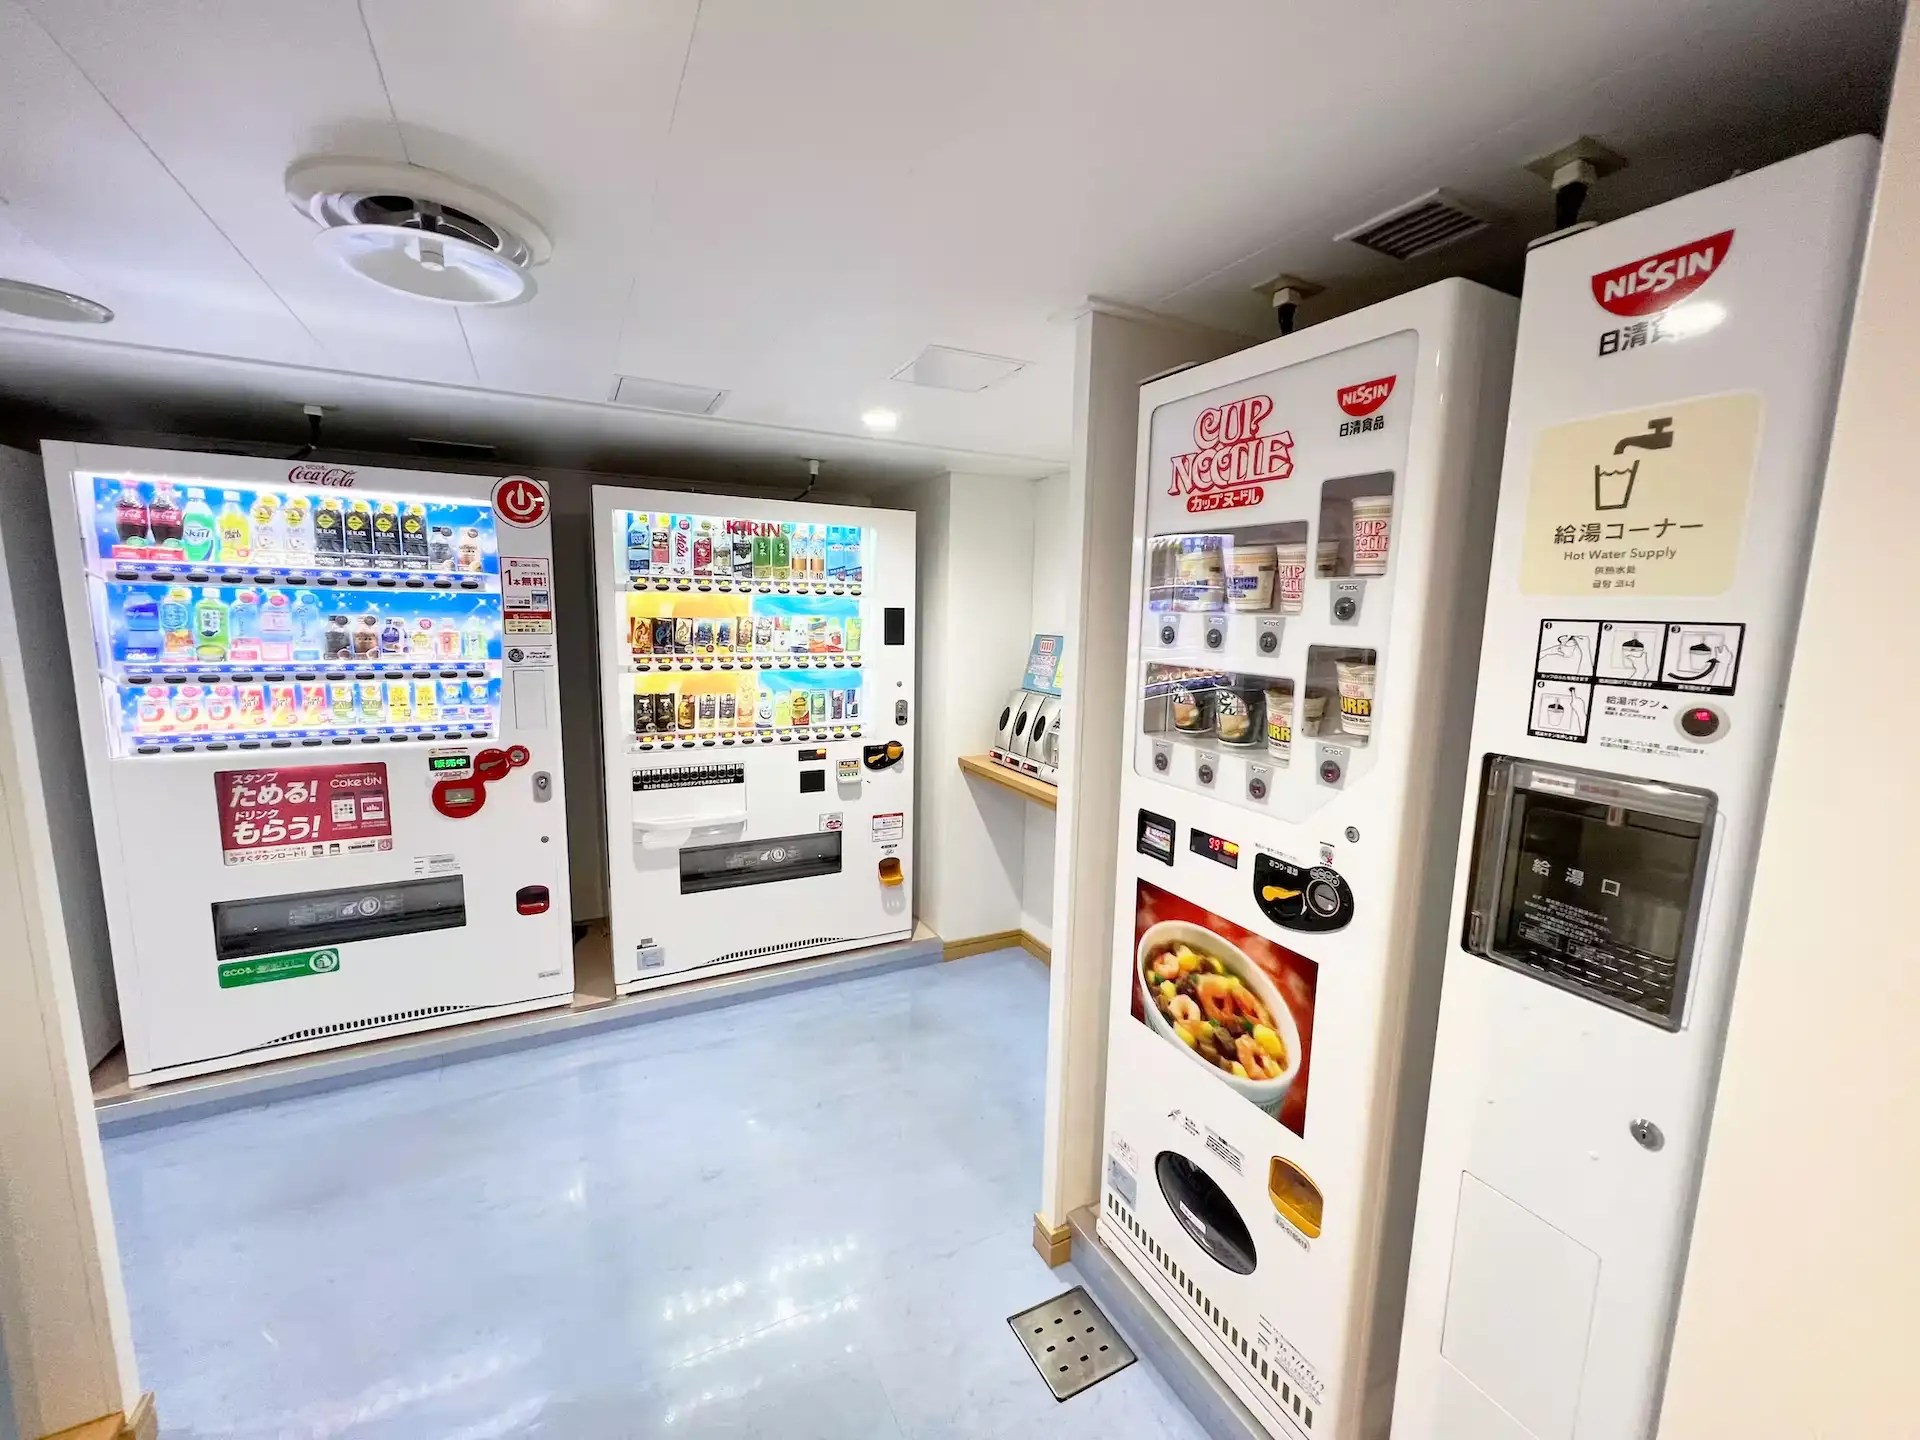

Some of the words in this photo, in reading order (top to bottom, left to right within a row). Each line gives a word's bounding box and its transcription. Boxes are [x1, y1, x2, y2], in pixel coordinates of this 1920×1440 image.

[1603, 247, 1714, 302] NISSIN
[1342, 381, 1390, 406] NISSIN
[1193, 394, 1273, 450] CUP
[1339, 416, 1385, 438] 日清食品
[1168, 431, 1294, 496] NOODLE
[1190, 487, 1261, 511] カップヌードル
[726, 520, 784, 538] KIRIN
[1553, 517, 1704, 545] 給湯コーナー
[1563, 550, 1585, 561] Hot
[1588, 548, 1626, 560] Water
[1630, 545, 1678, 560] Supply
[1340, 698, 1372, 716] URR
[1268, 724, 1291, 742] URR
[232, 772, 278, 785] スタンプ
[330, 778, 361, 789] Coke
[363, 775, 382, 786] ON
[230, 780, 319, 808] ためる!
[235, 809, 280, 821] ドリンク
[232, 815, 321, 846] もらう!
